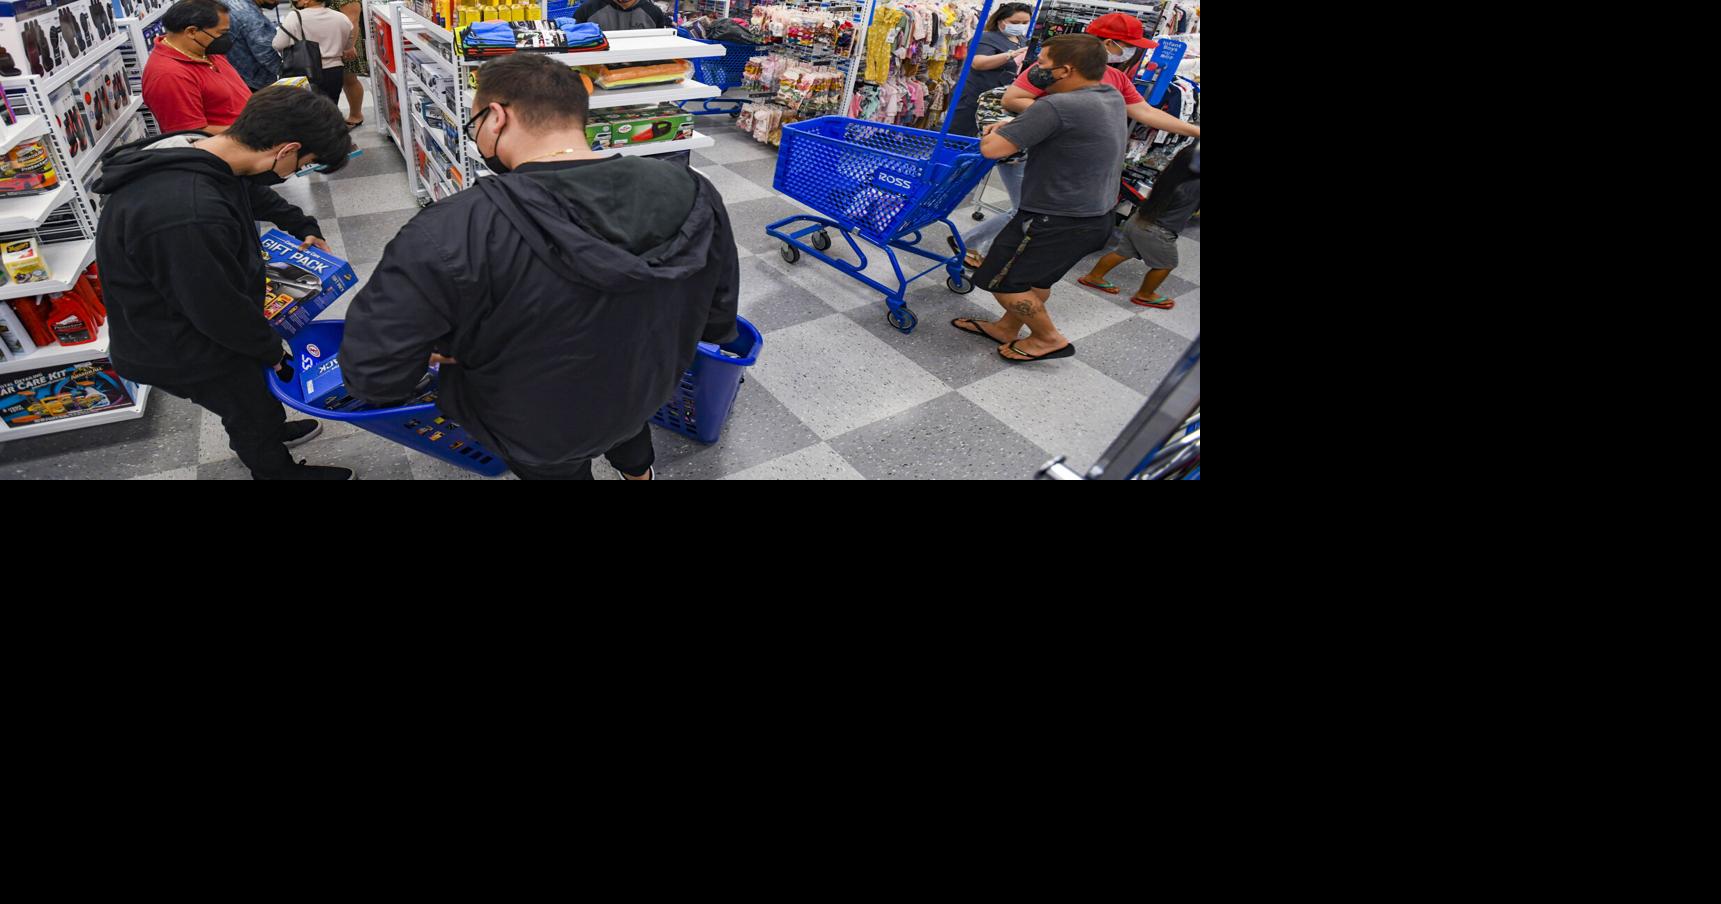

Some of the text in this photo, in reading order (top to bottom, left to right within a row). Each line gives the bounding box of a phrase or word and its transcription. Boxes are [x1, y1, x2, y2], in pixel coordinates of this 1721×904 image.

[878, 172, 912, 189] ROSS
[261, 238, 330, 274] GIFT PACK
[0, 369, 67, 396] AR CARE KIT
